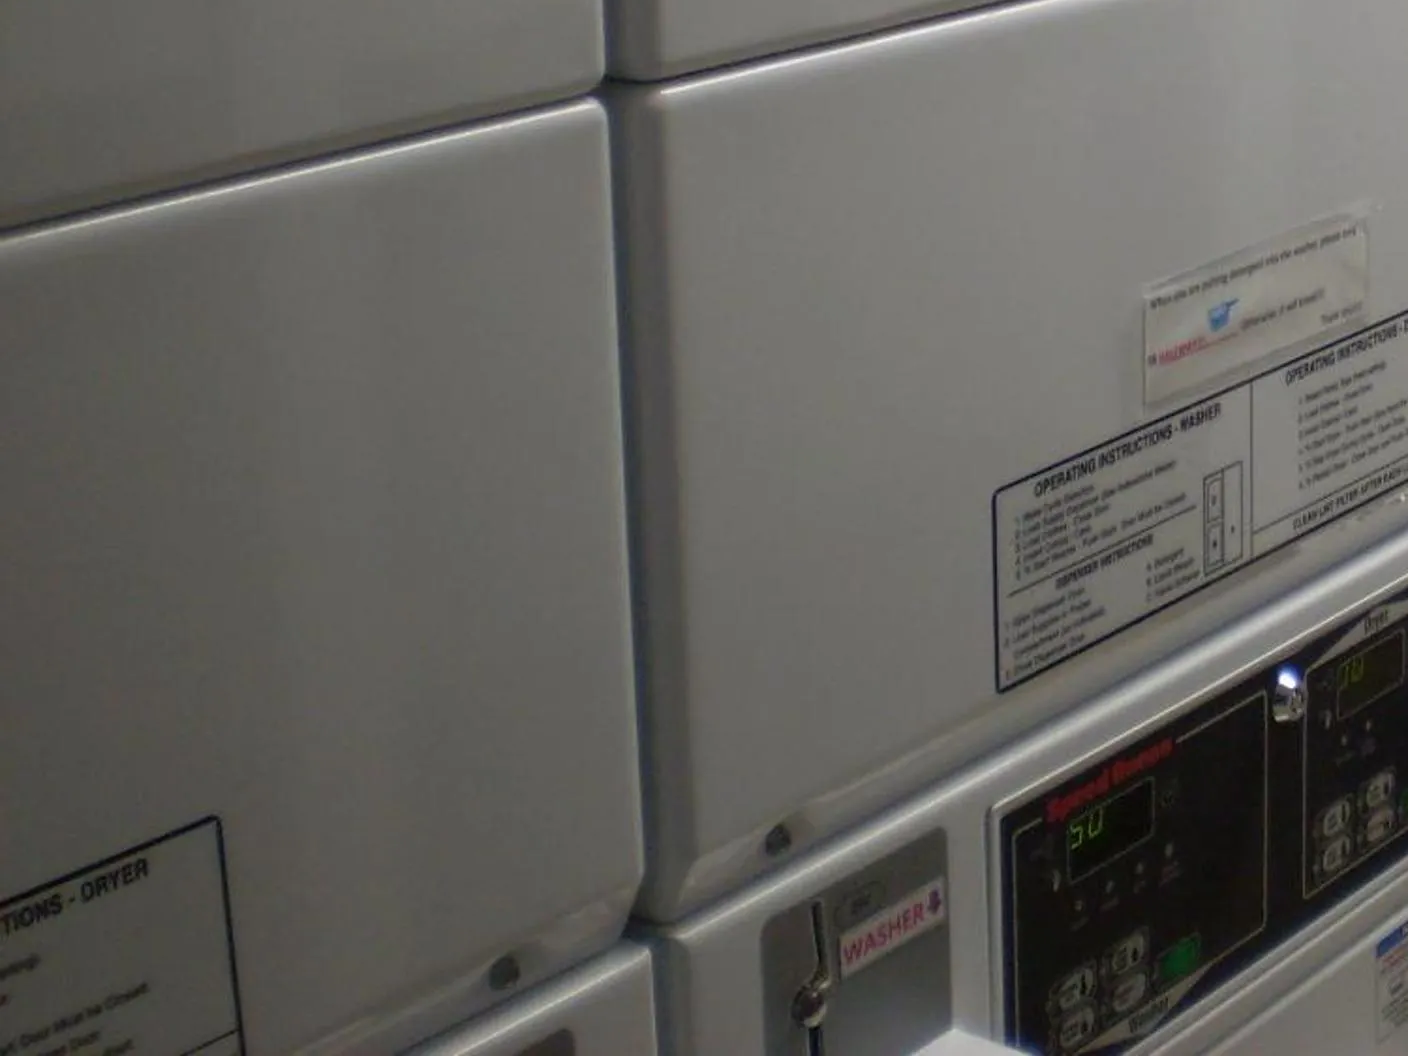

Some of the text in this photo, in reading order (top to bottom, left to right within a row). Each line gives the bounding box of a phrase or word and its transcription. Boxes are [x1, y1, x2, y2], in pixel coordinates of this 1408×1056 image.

[1285, 354, 1334, 386] OPERATING
[1337, 329, 1397, 362] INSTRUCTIONS
[1034, 461, 1096, 495] OPERATING
[1099, 428, 1172, 468] INSTRUCTIONS
[1180, 404, 1221, 431] WASHER
[80, 858, 148, 904] DRYER
[843, 902, 924, 965] WASHER
